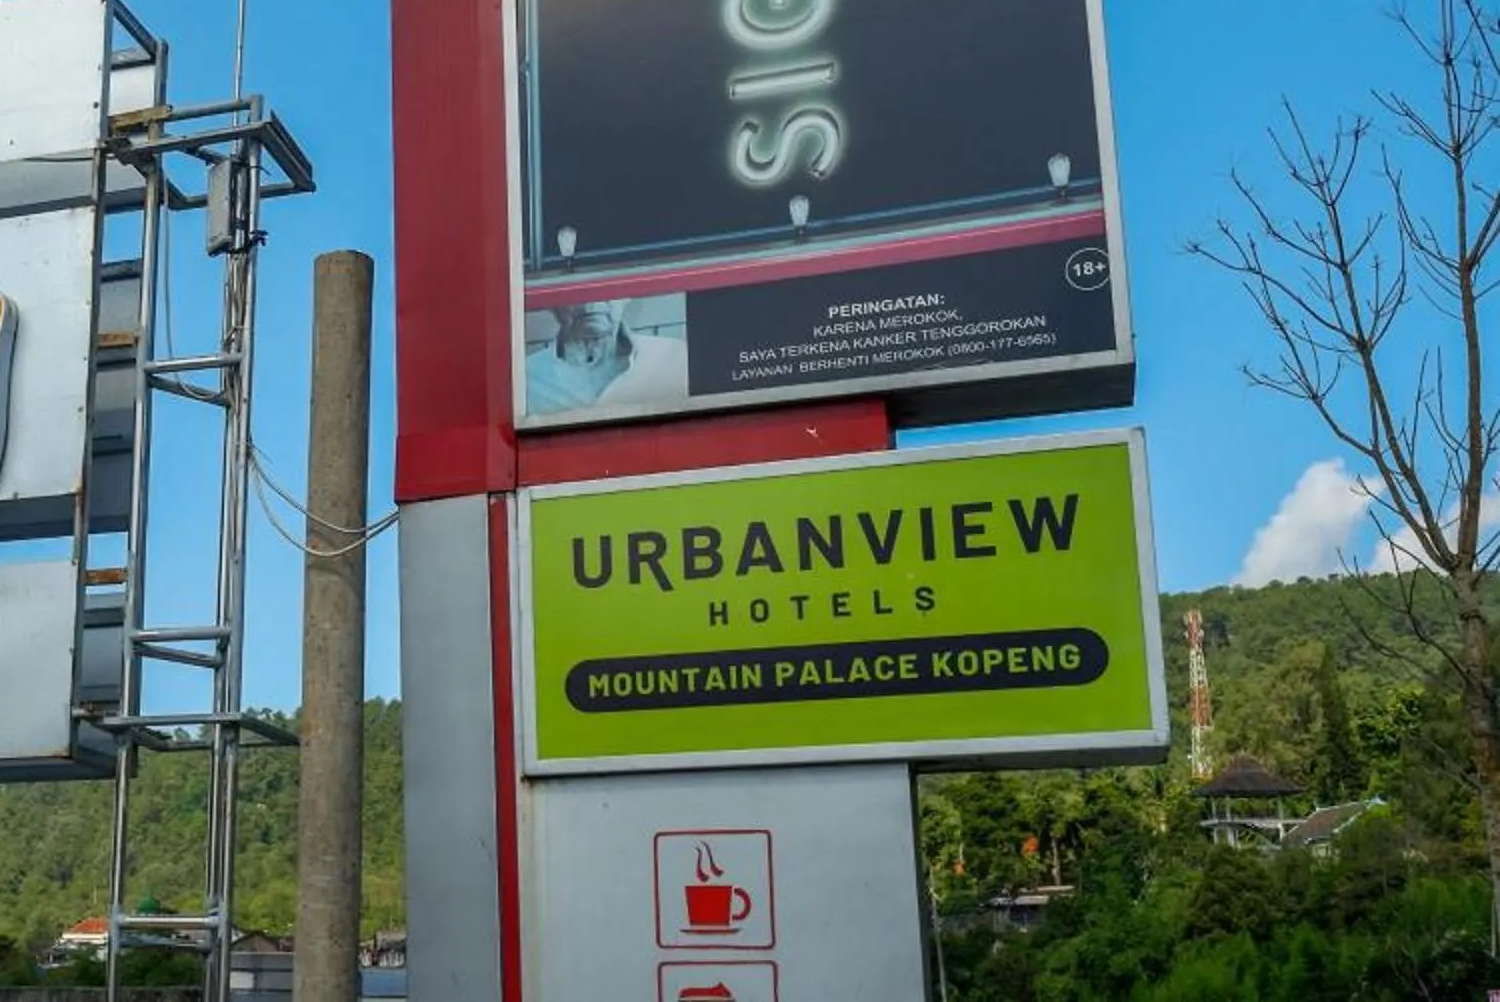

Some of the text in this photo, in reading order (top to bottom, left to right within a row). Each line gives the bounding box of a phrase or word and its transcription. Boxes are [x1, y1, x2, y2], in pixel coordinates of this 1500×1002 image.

[1073, 262, 1106, 277] 18+
[828, 293, 945, 318] PERINGATAN:
[739, 315, 1046, 363] SAYA TERKENA KANKER TENGGOROKAN
[813, 319, 877, 337] KARENA
[731, 364, 793, 381] LAYANAN
[799, 355, 870, 373] BERHENTI
[872, 345, 945, 364] MEROKOK
[571, 493, 1080, 591] URBANVIEW
[708, 586, 937, 626] HOTELS
[588, 643, 1082, 698] MOUNTAIN PALACE KOPENG
